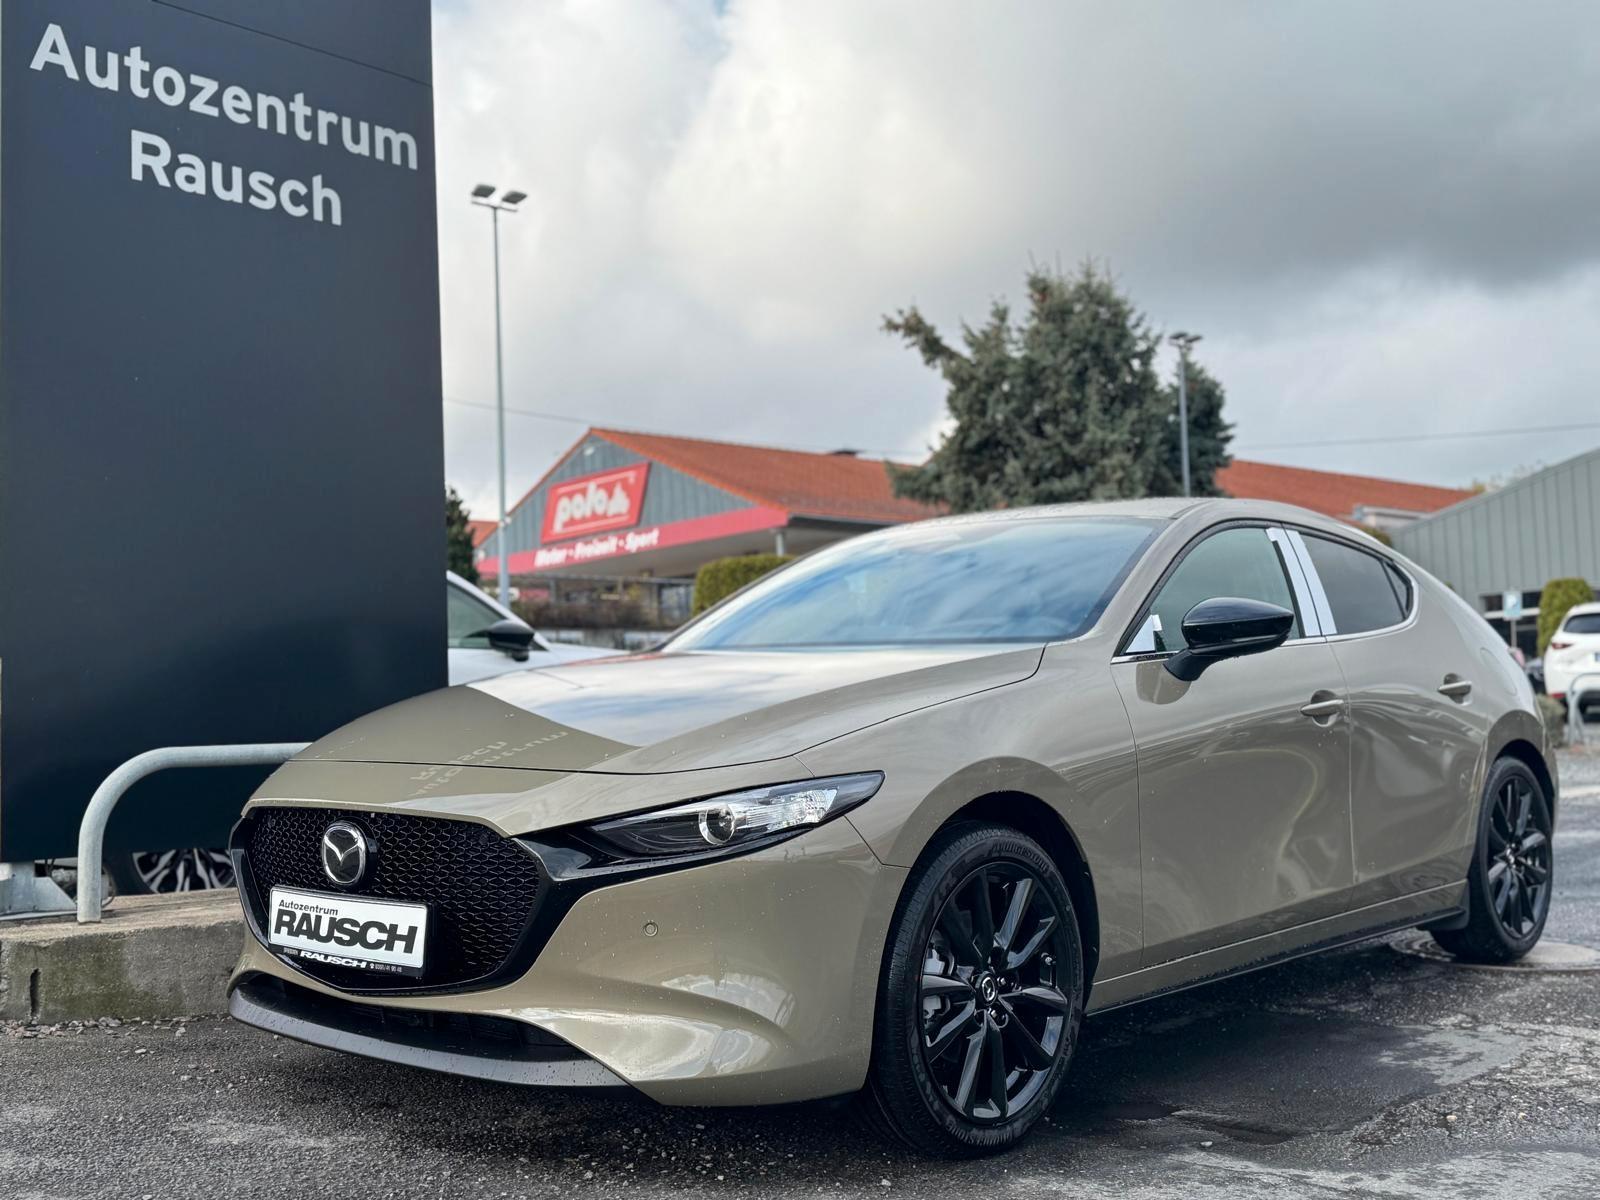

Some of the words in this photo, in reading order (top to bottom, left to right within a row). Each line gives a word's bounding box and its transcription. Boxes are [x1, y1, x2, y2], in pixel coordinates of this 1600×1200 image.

[29, 23, 418, 170] Autozentrum
[130, 129, 342, 226] Rausch
[553, 481, 608, 534] polo
[624, 528, 659, 553] Sport
[278, 899, 338, 916] Autozentrum
[274, 908, 418, 954] RAUSCH
[300, 950, 367, 969] RAUSCH
